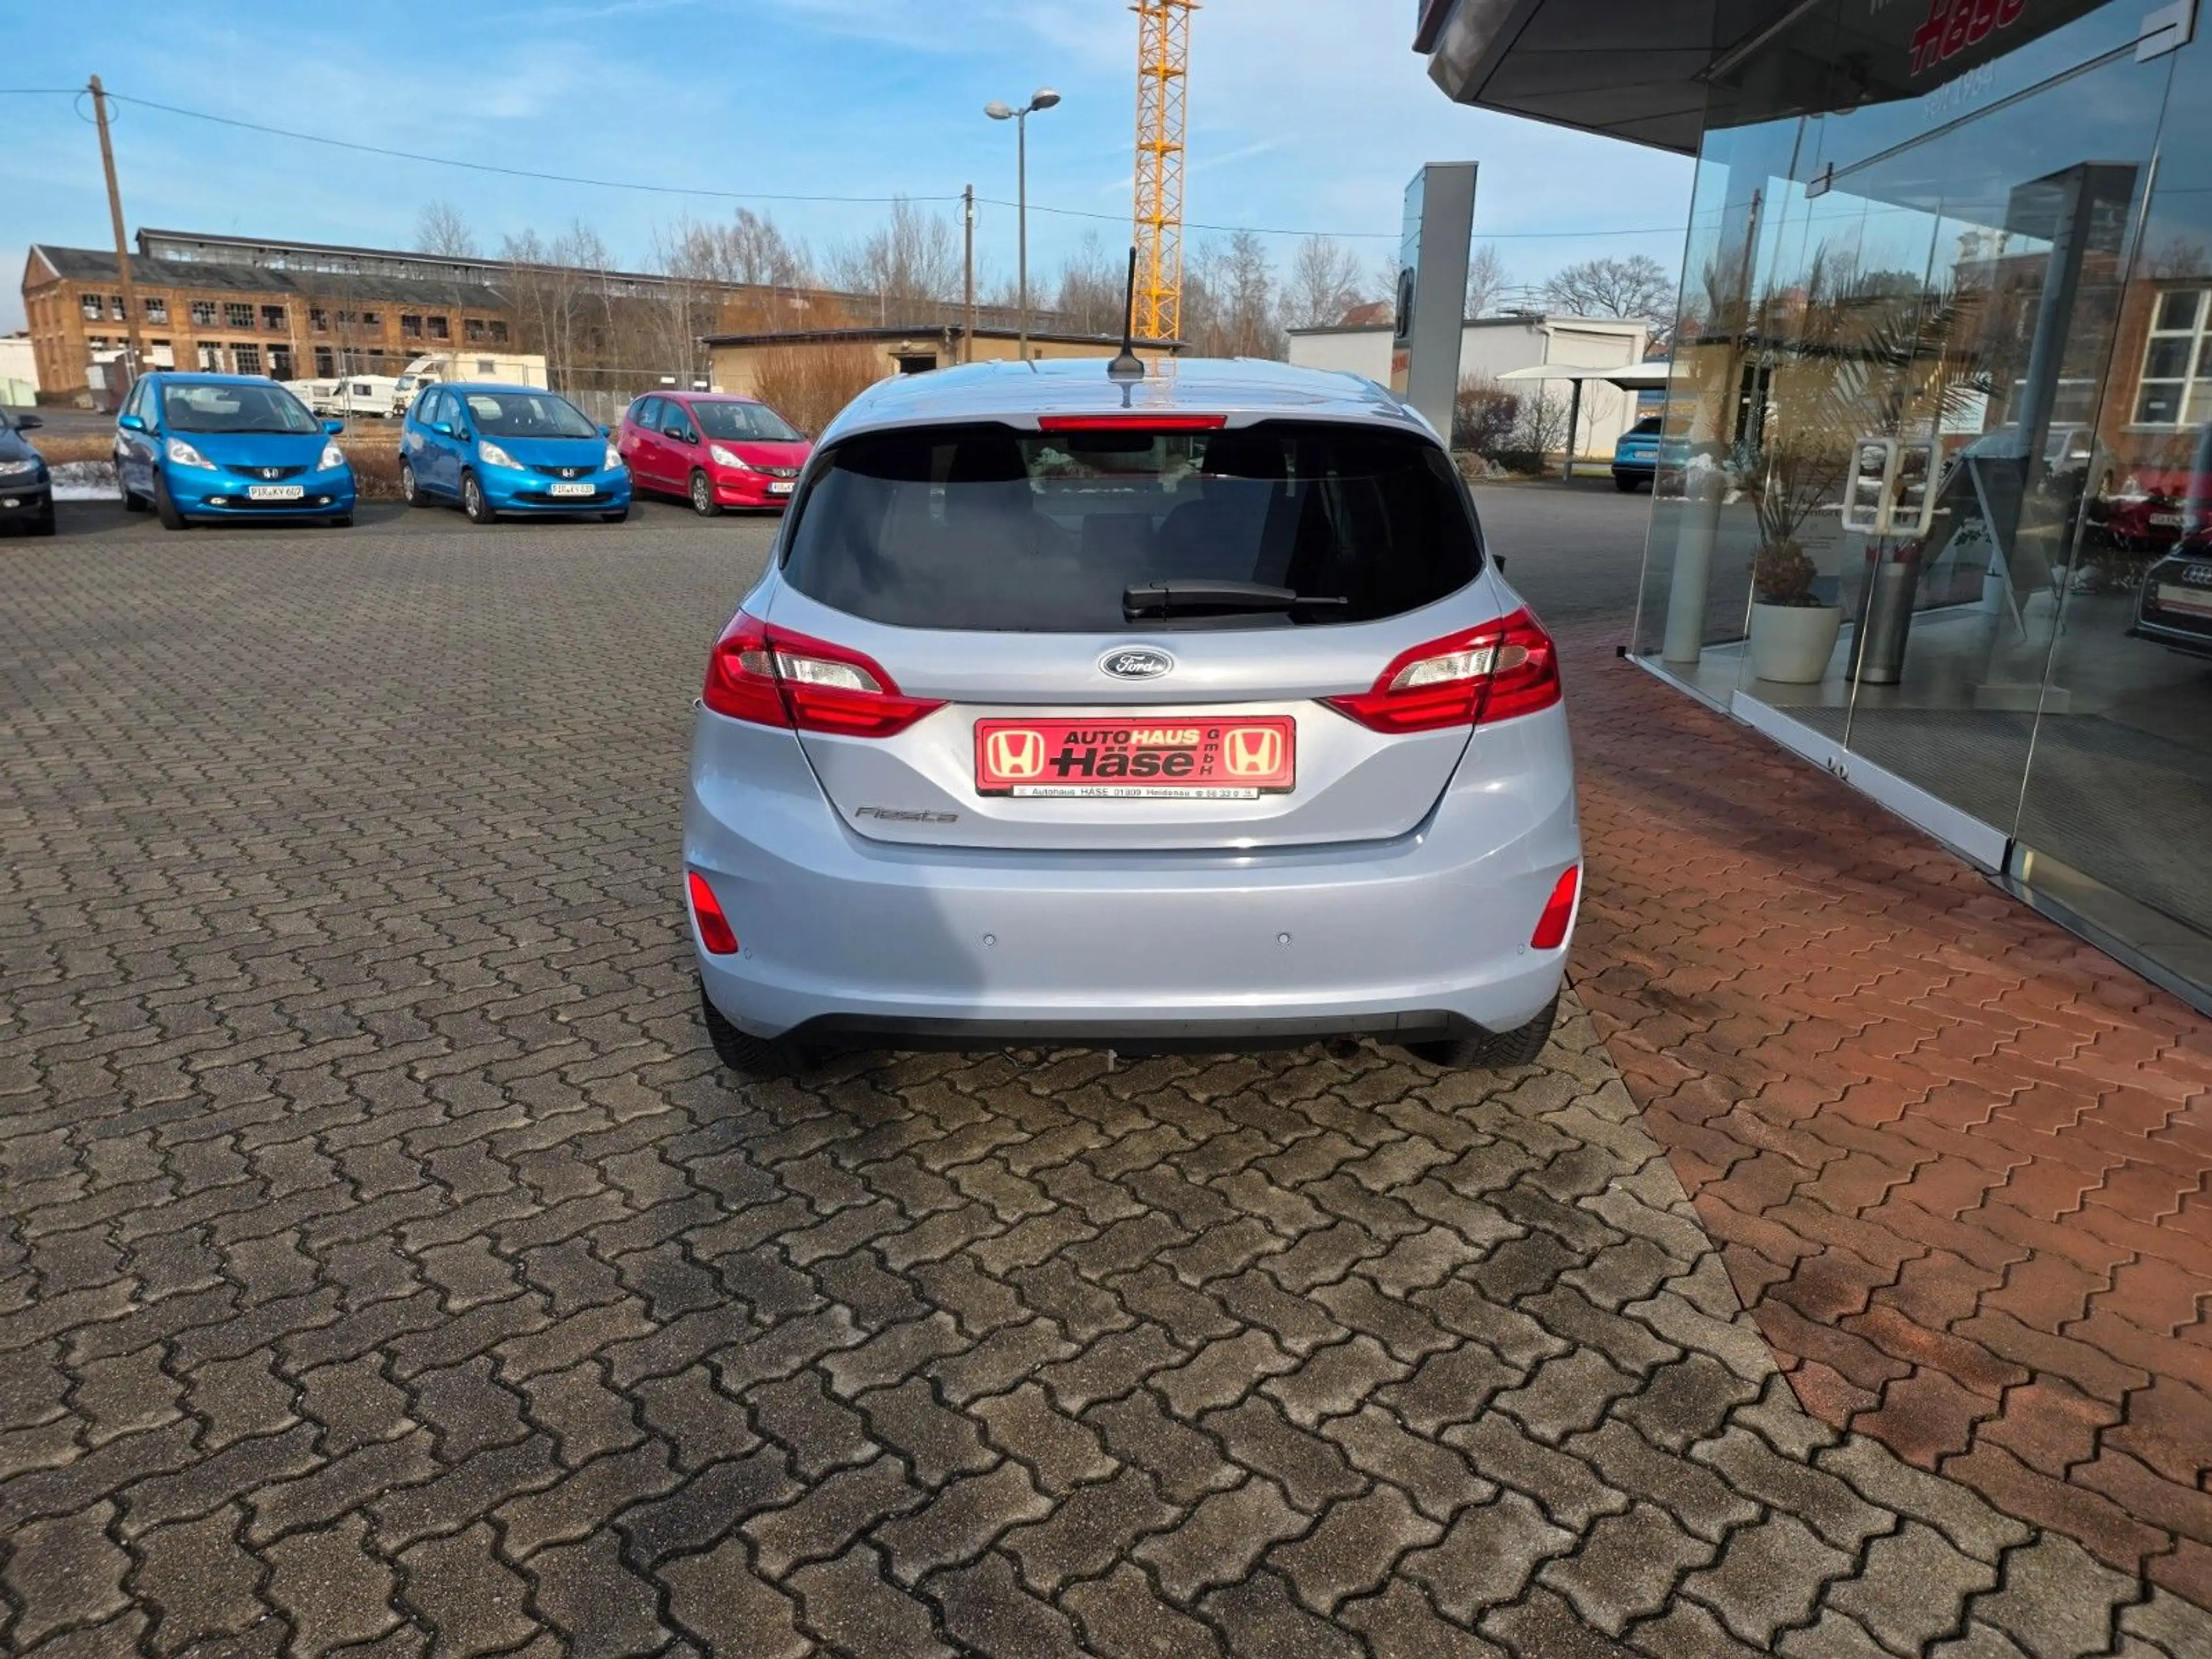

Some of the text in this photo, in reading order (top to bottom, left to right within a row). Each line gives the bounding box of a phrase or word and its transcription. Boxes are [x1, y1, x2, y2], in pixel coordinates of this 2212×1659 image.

[1116, 655, 1156, 672] Ford
[1063, 729, 1200, 745] AUTOHAUS
[1049, 747, 1195, 777] Häse
[1032, 787, 1075, 796] Autohaus
[854, 806, 959, 823] Fiesta
